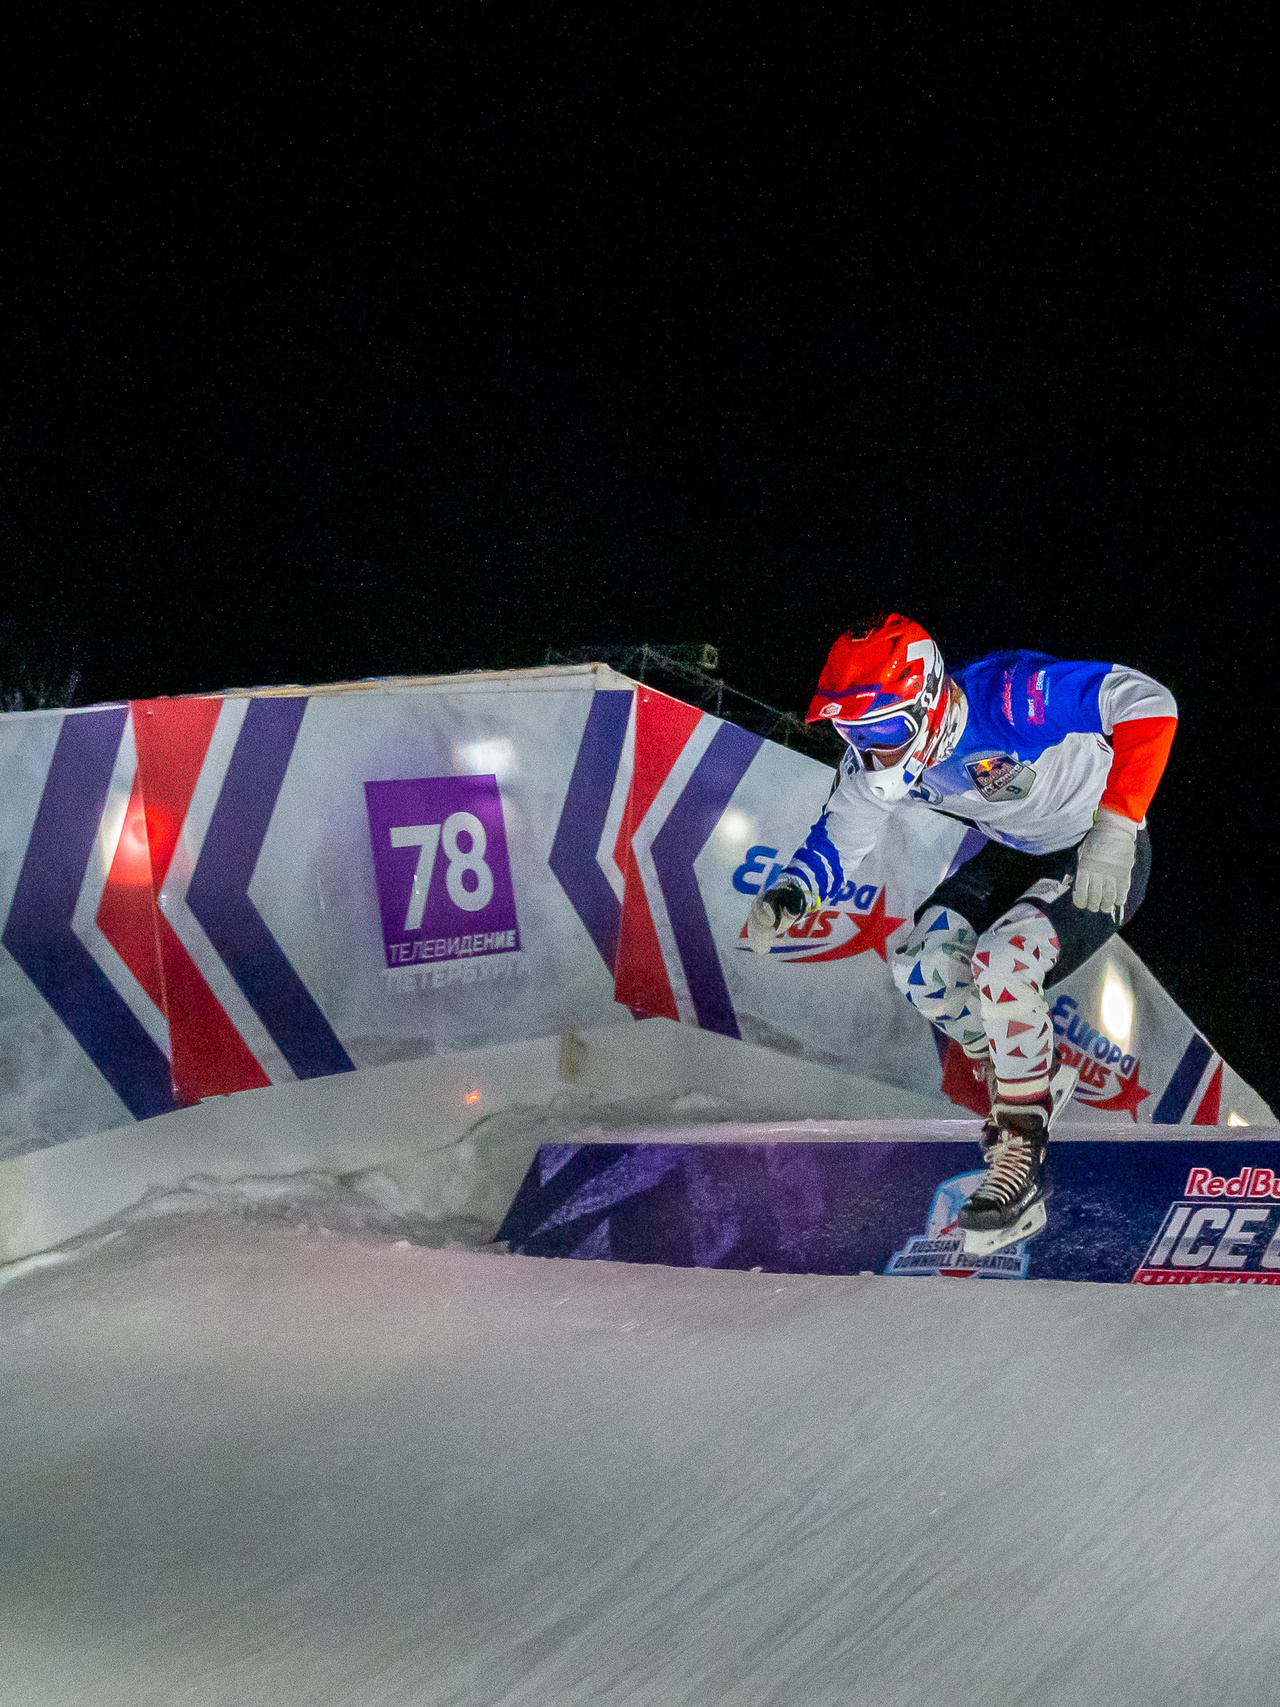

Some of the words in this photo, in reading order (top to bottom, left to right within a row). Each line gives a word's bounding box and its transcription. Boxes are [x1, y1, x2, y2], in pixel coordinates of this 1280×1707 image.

[390, 811, 494, 931] 78
[389, 930, 516, 963] ТЕЛЕВИДЕНИЕ
[1050, 995, 1135, 1075] Europa
[1185, 1168, 1250, 1197] Red
[909, 1240, 960, 1253] RUSSIAN
[1150, 1207, 1268, 1268] ICE
[893, 1254, 953, 1268] DOWNHILL
